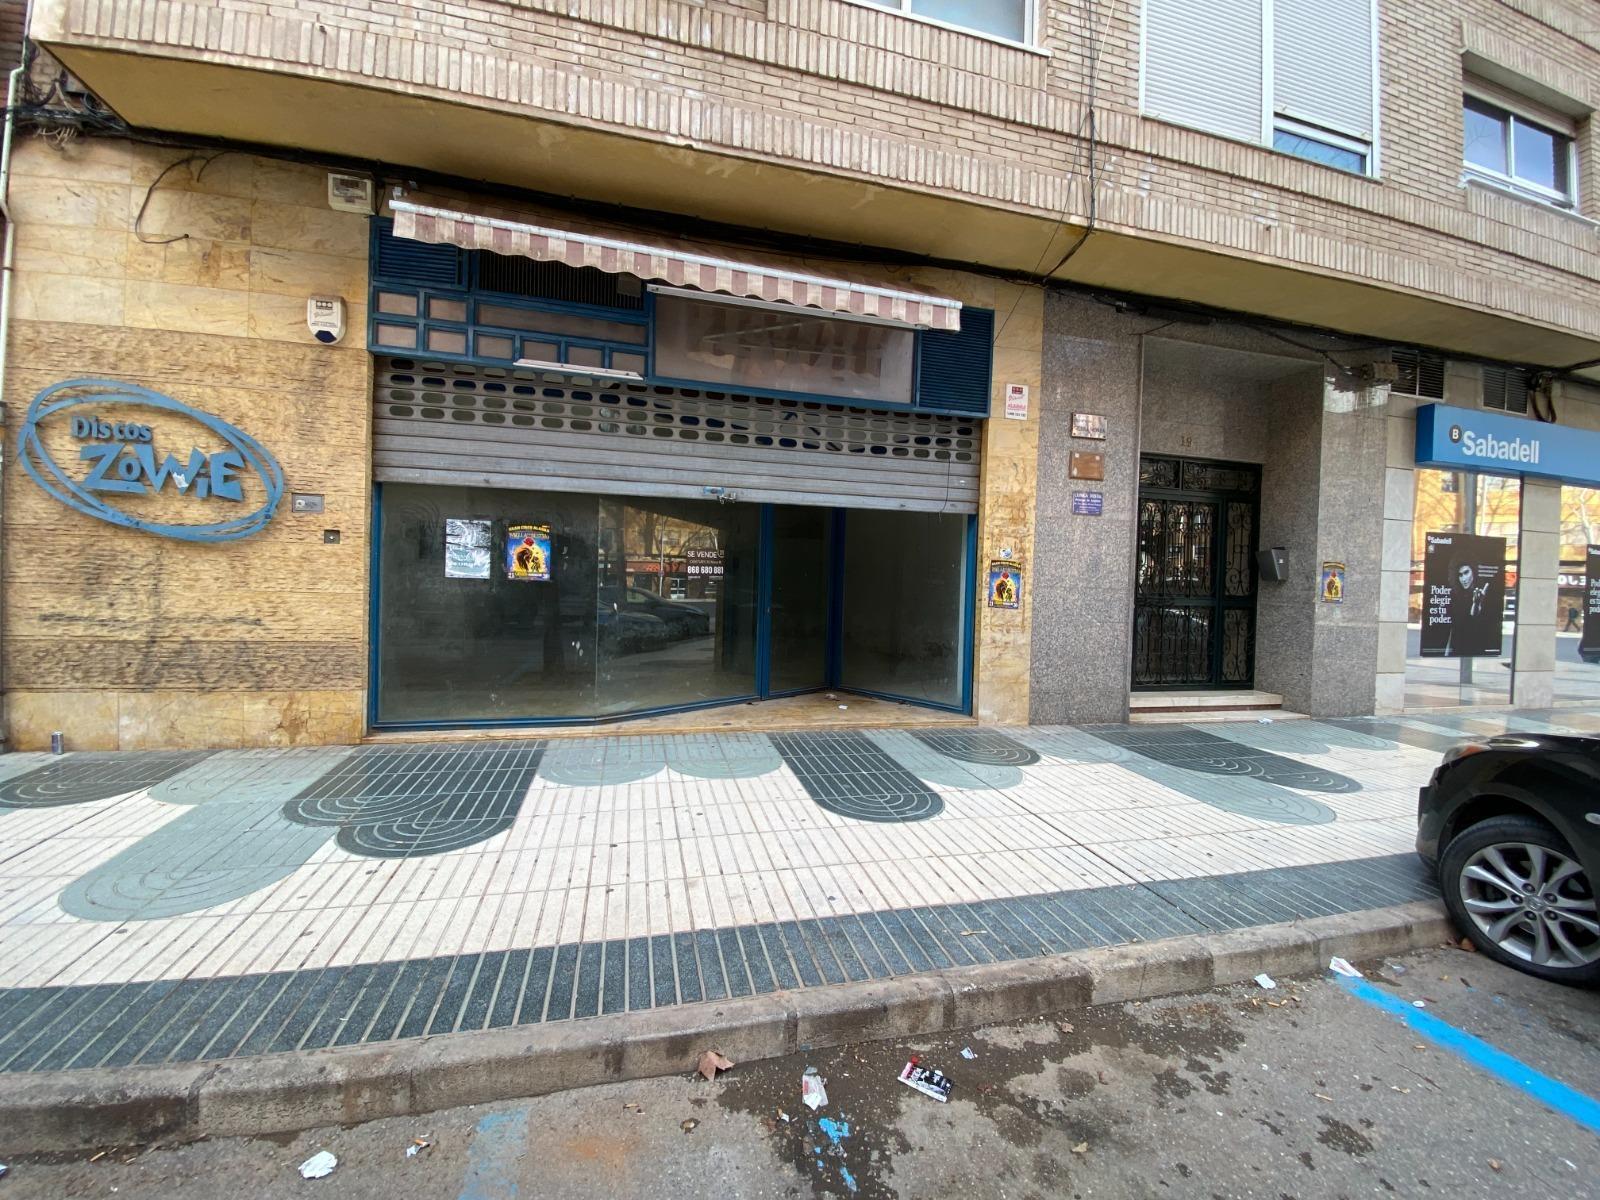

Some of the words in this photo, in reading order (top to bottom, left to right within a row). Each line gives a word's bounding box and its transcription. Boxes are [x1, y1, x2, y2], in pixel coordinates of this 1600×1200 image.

[71, 415, 153, 441] Discos
[1462, 430, 1540, 464] Sabadell
[1430, 536, 1452, 545] Sabadell
[687, 550, 695, 558] SE
[696, 551, 717, 559] VENDE
[1430, 585, 1452, 594] Poder
[1430, 595, 1452, 606] elegir
[1429, 607, 1438, 615] es
[1438, 606, 1447, 614] tu
[1429, 614, 1452, 626] poder.
